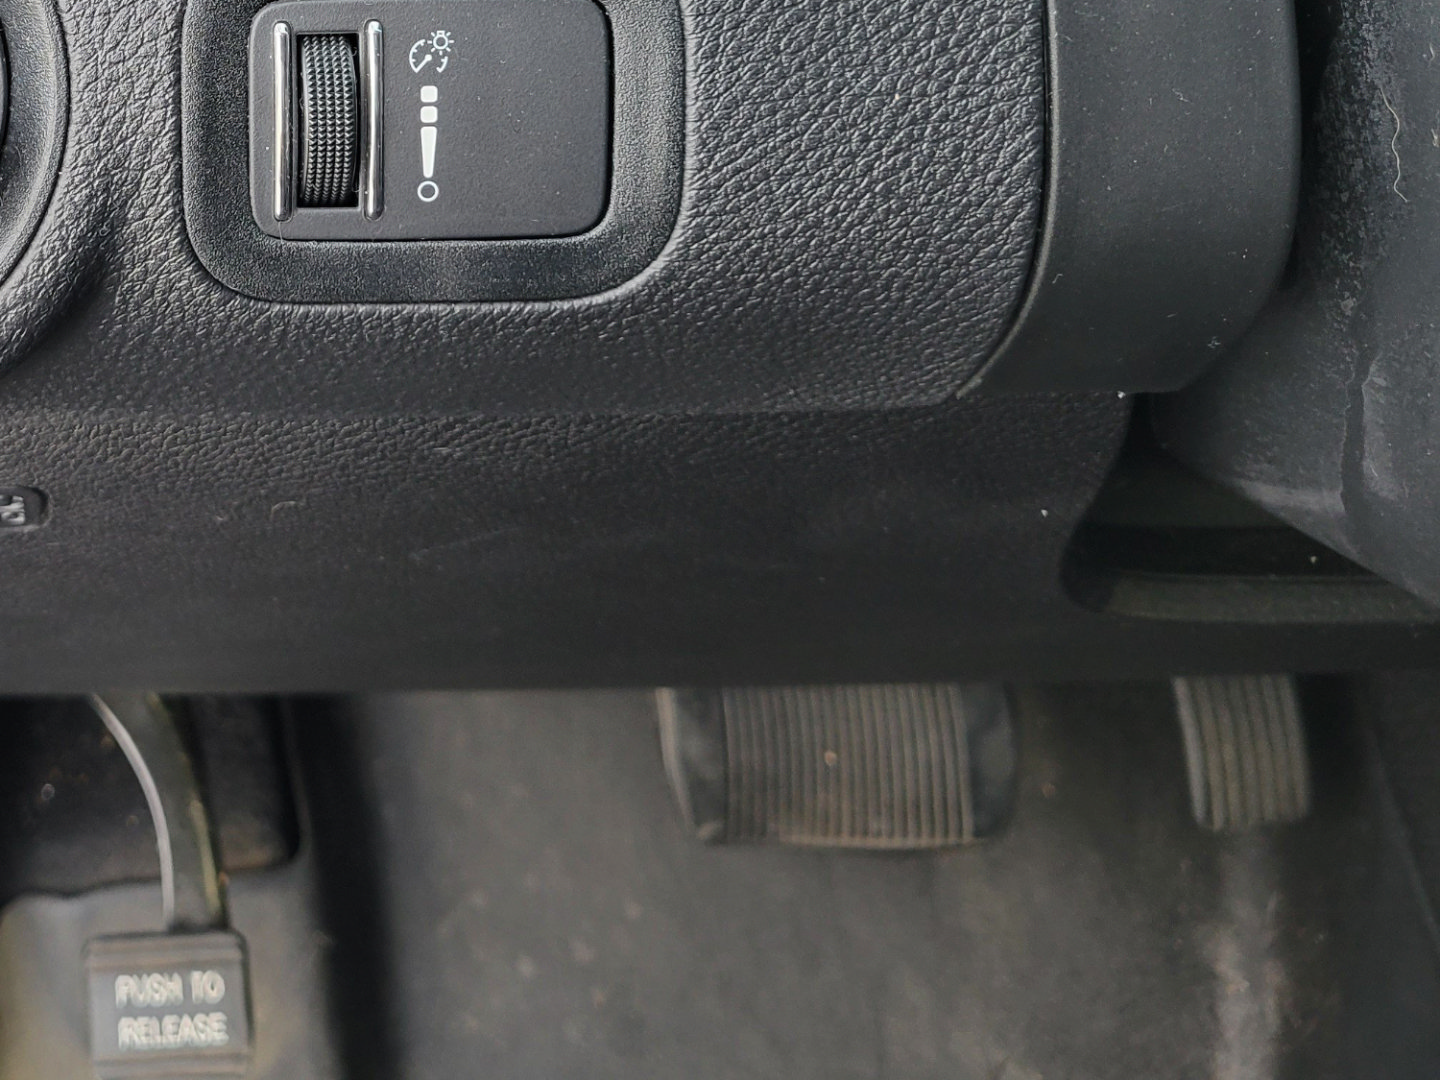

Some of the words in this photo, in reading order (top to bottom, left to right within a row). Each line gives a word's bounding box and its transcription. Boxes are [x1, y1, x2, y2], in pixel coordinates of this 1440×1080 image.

[114, 972, 184, 1009] PUSH
[190, 969, 226, 1005] TO
[117, 1011, 230, 1051] RELEASE
